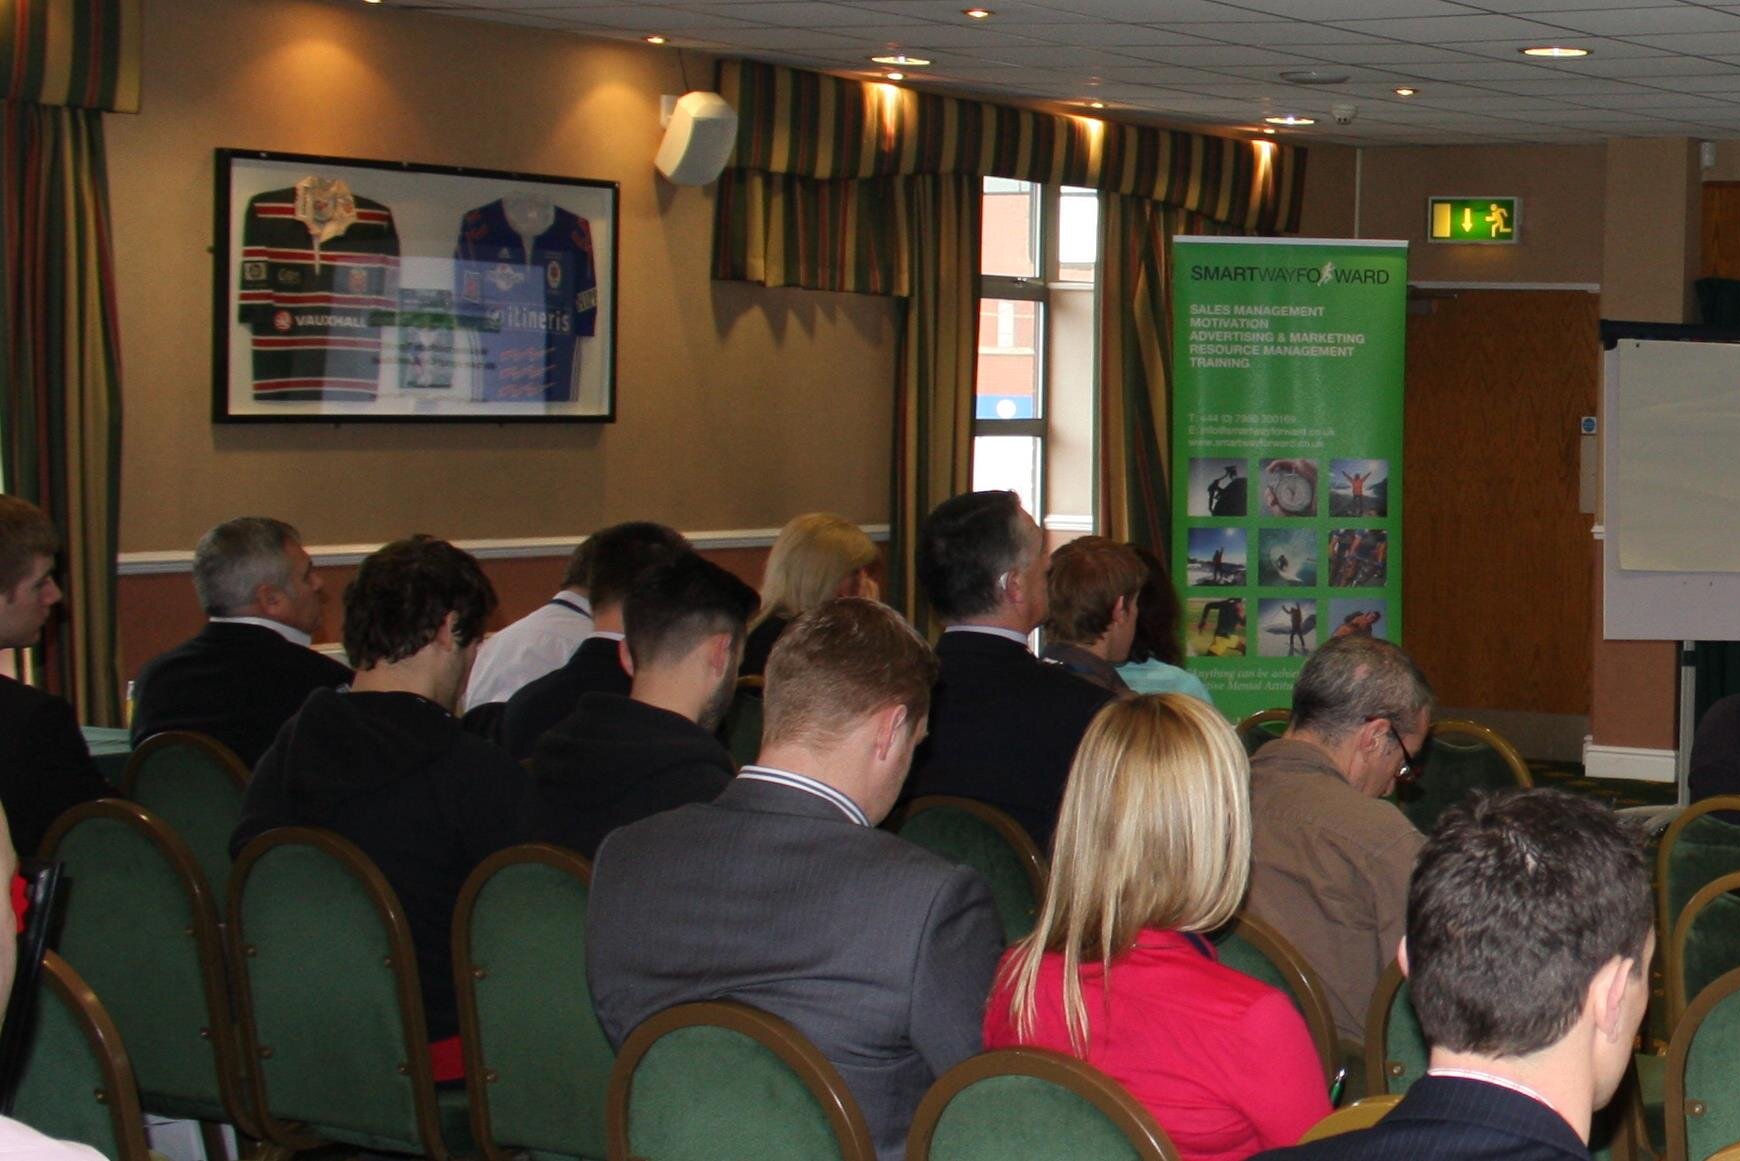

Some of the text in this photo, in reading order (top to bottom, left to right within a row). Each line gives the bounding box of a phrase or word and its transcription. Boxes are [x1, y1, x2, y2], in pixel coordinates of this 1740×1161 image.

[1190, 304, 1325, 317] SALES MANAGEMENT
[295, 315, 367, 328] VAUXHALL
[1190, 318, 1269, 329] MOTIVATION
[1189, 331, 1366, 344] ADVERTISING & MARKETING
[1189, 344, 1355, 357] RESOURCE MANAGEMENT
[1190, 357, 1250, 368] TRAINING
